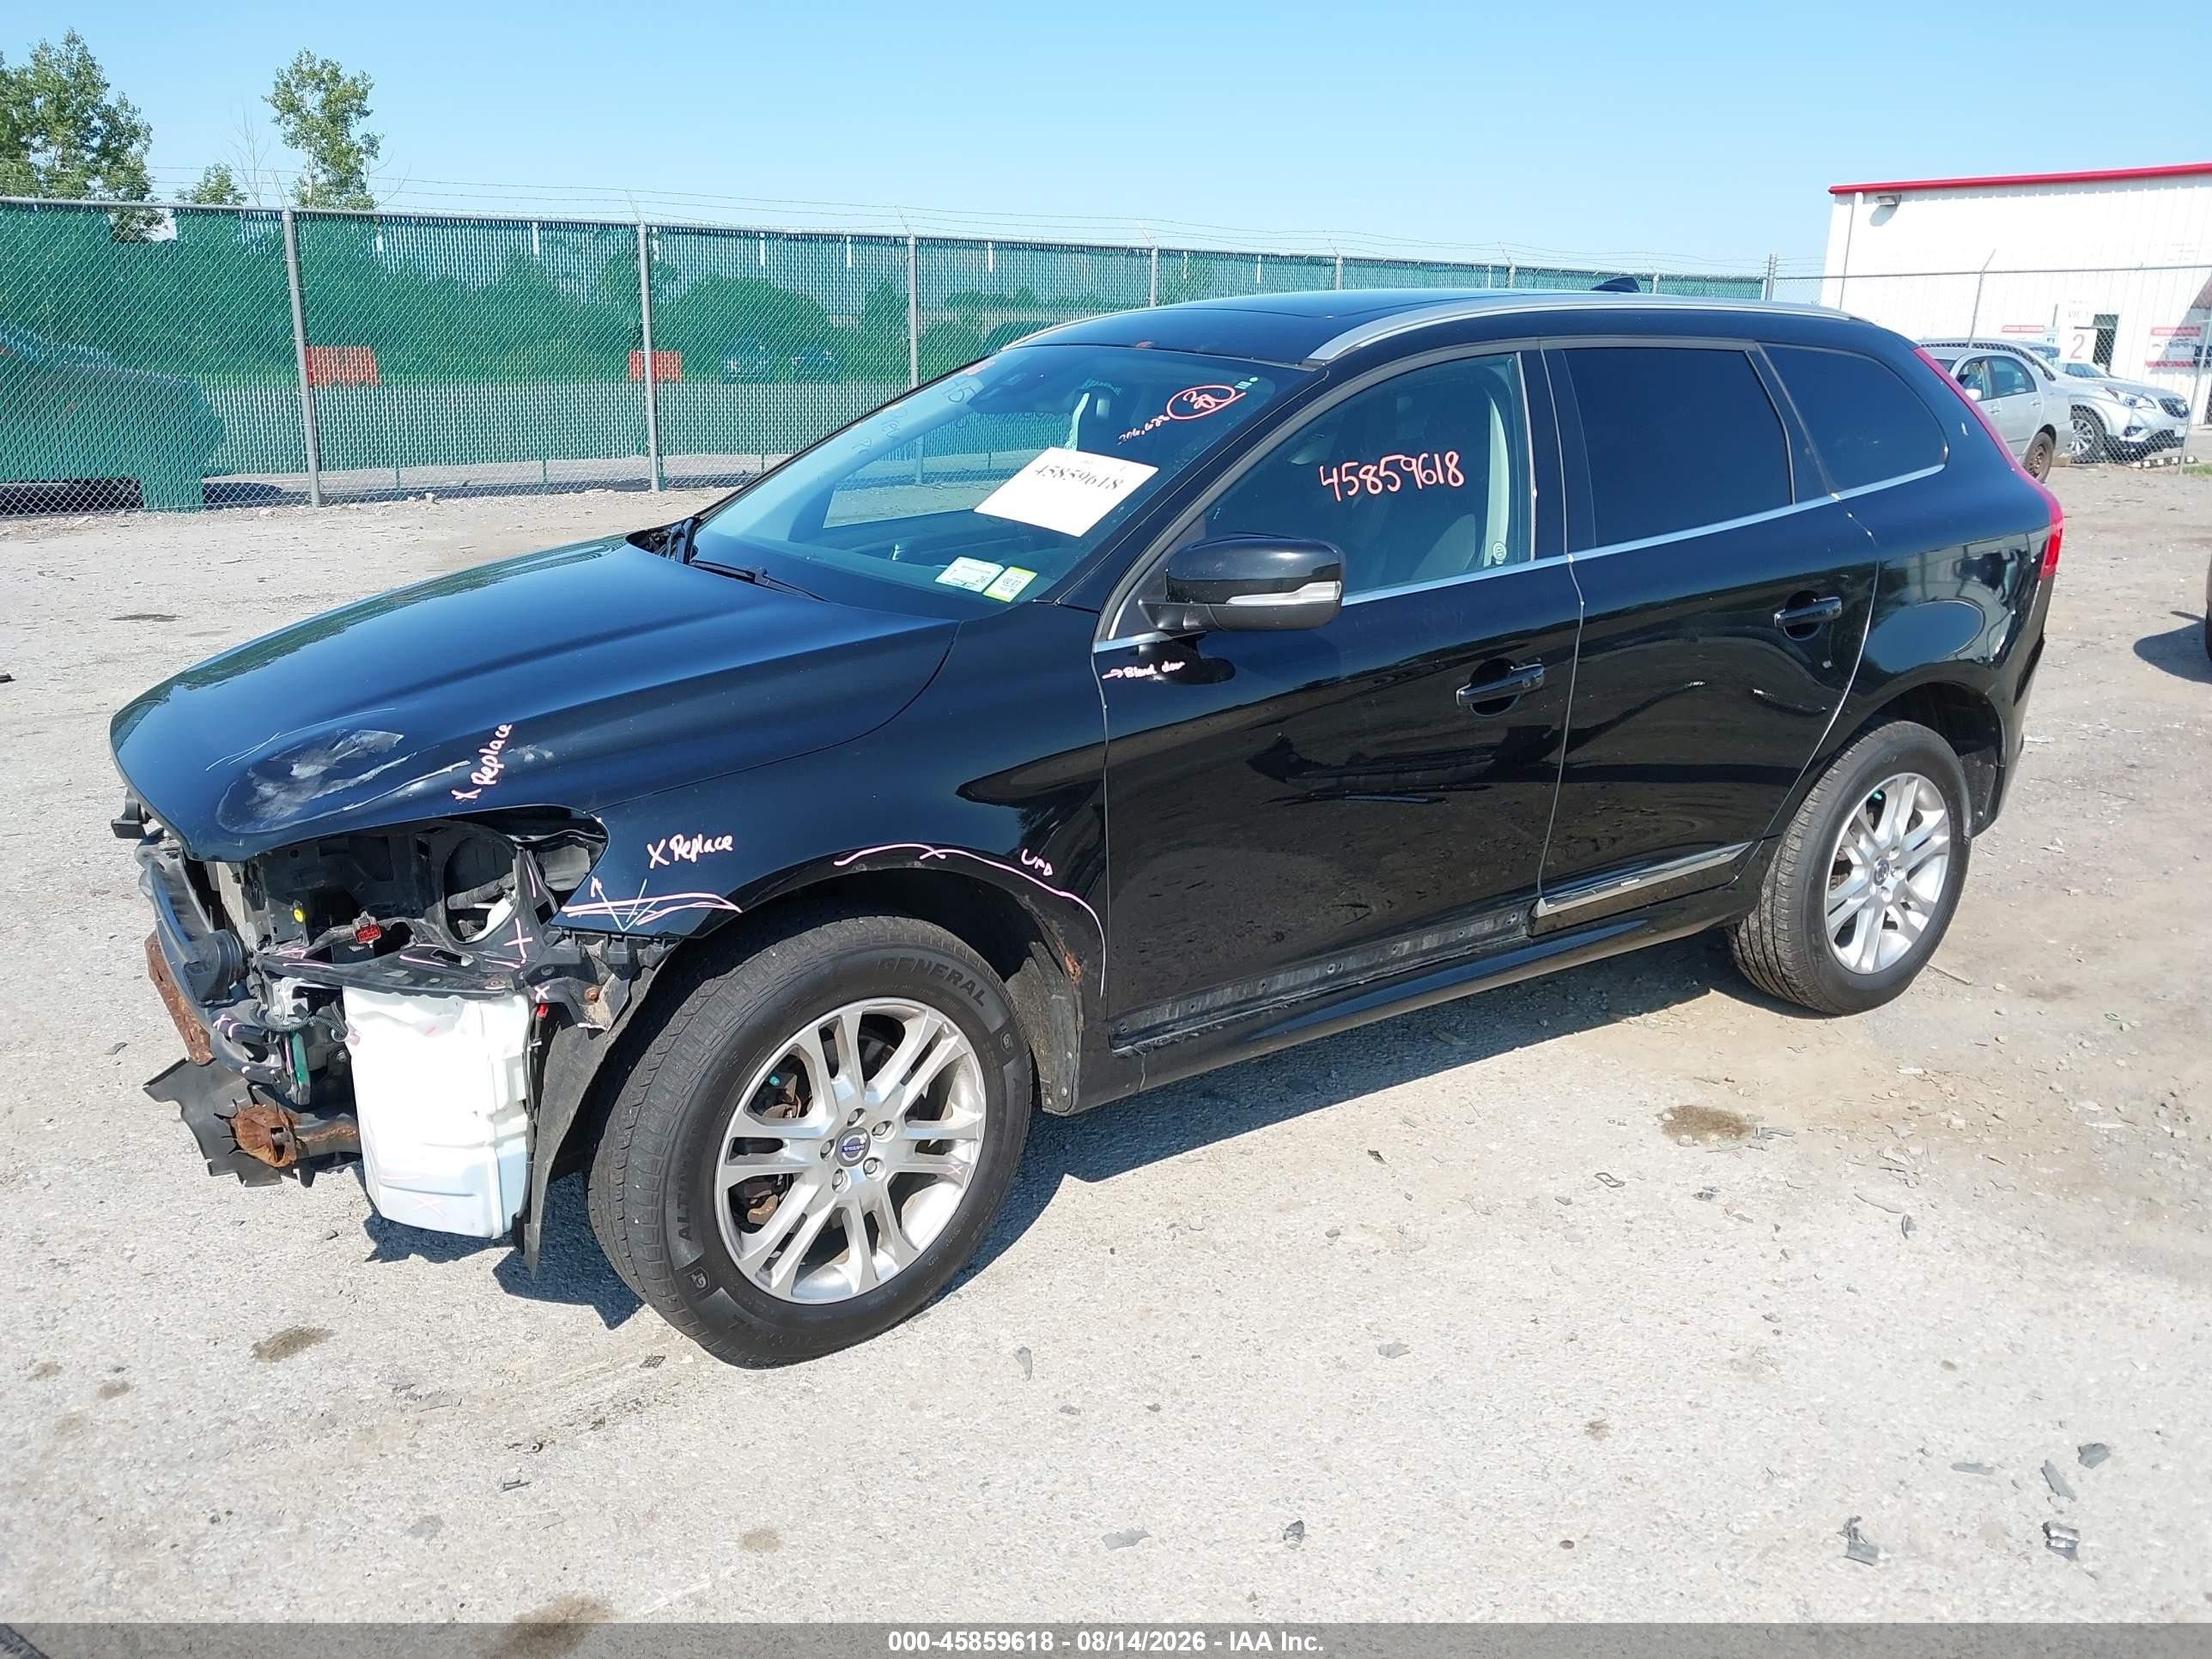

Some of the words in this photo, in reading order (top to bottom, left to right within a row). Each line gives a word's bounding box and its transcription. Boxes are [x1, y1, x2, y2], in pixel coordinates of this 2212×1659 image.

[2069, 333, 2086, 359] 2
[1035, 465, 1125, 490] 45859618
[1319, 451, 1465, 501] 45859618
[470, 724, 513, 786] Replace
[669, 834, 733, 863] Replace
[878, 957, 986, 1007] GENERAL
